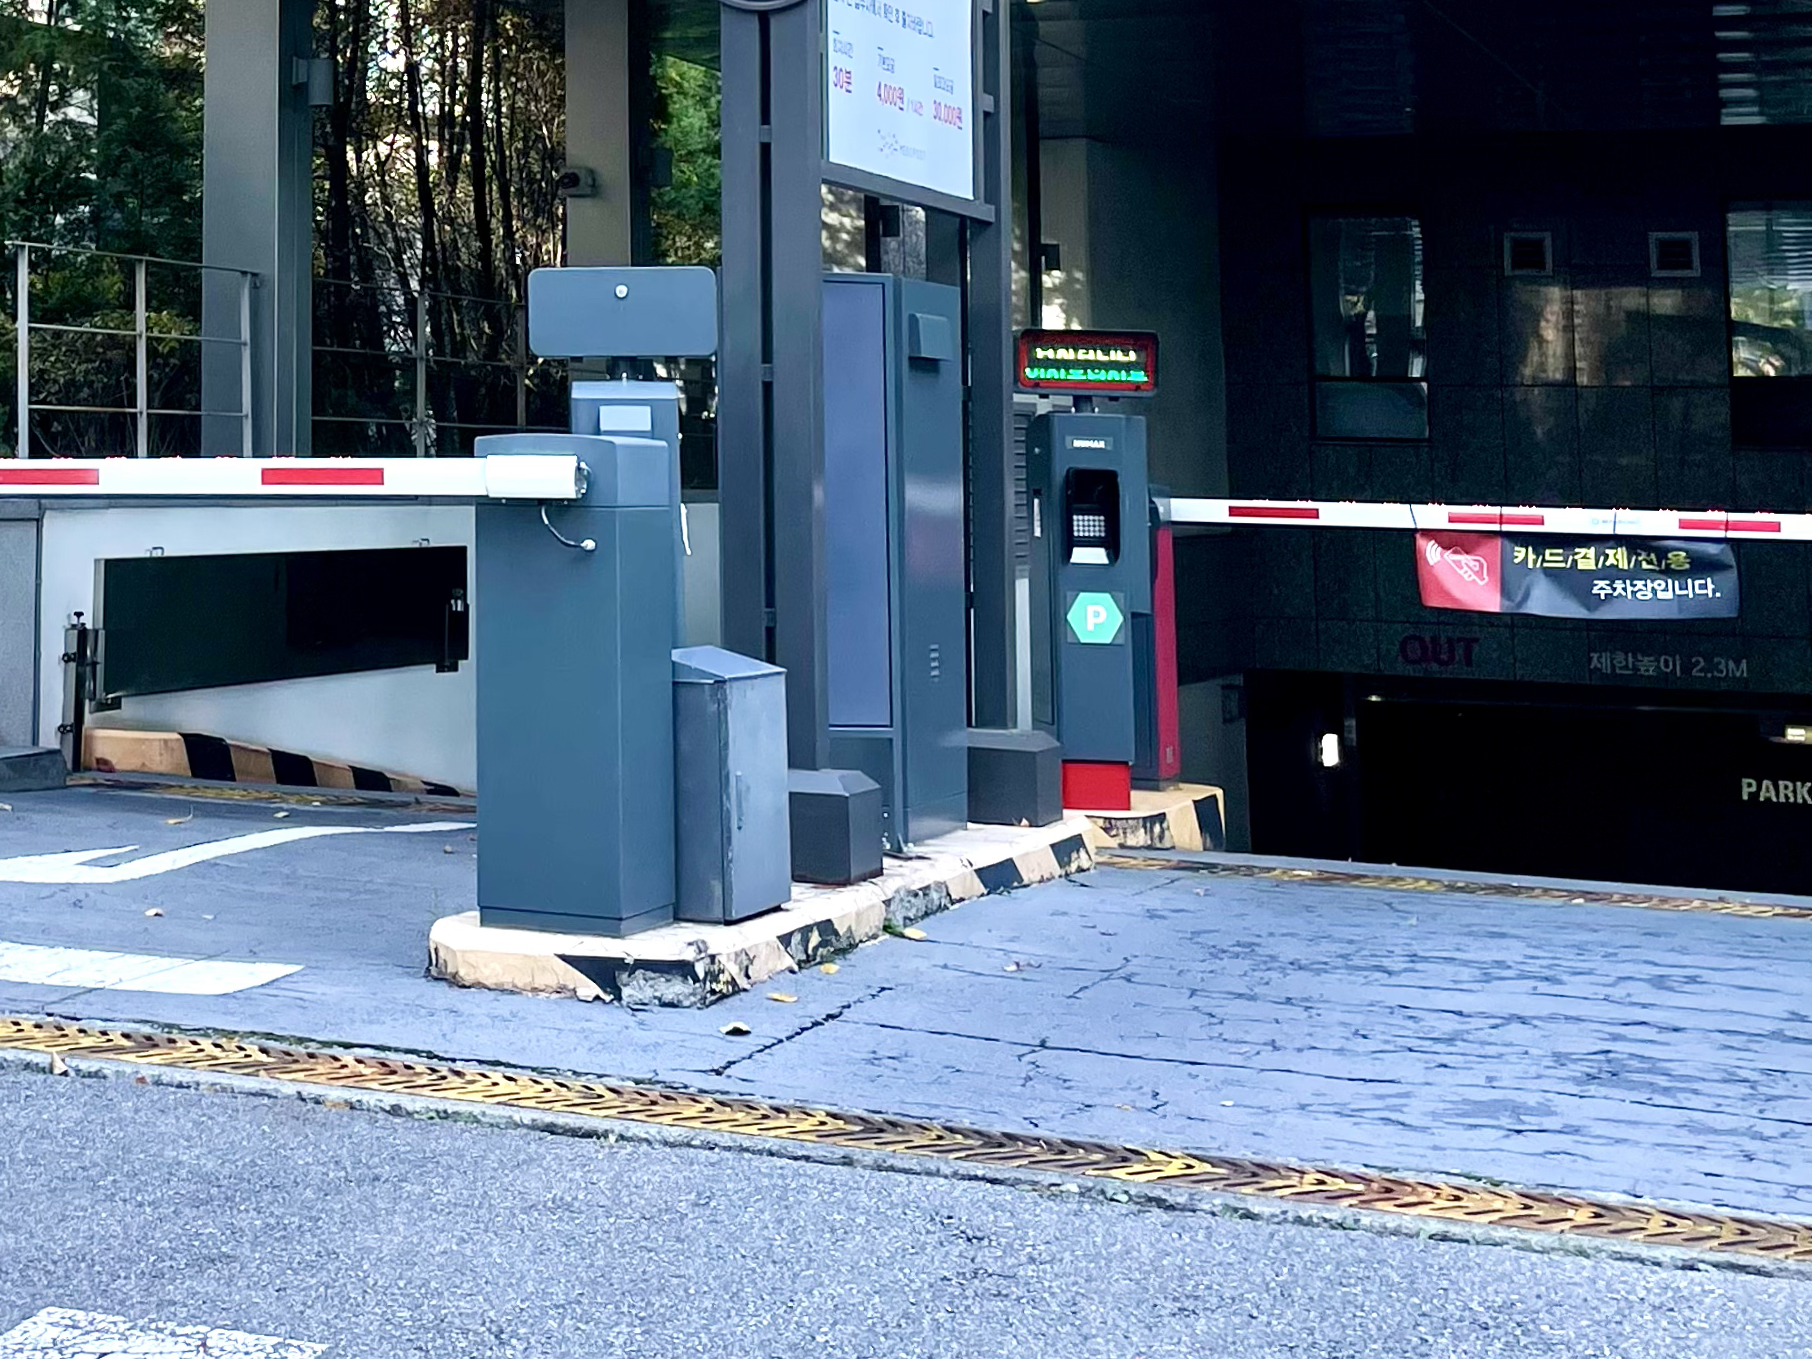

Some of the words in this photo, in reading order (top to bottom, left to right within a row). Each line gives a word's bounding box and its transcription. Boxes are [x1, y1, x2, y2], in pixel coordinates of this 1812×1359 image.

[832, 65, 853, 94] 30분
[1086, 604, 1107, 632] P
[1398, 632, 1481, 668] OUT
[1589, 651, 1682, 677] 제한높이
[1691, 655, 1749, 679] 2.3M
